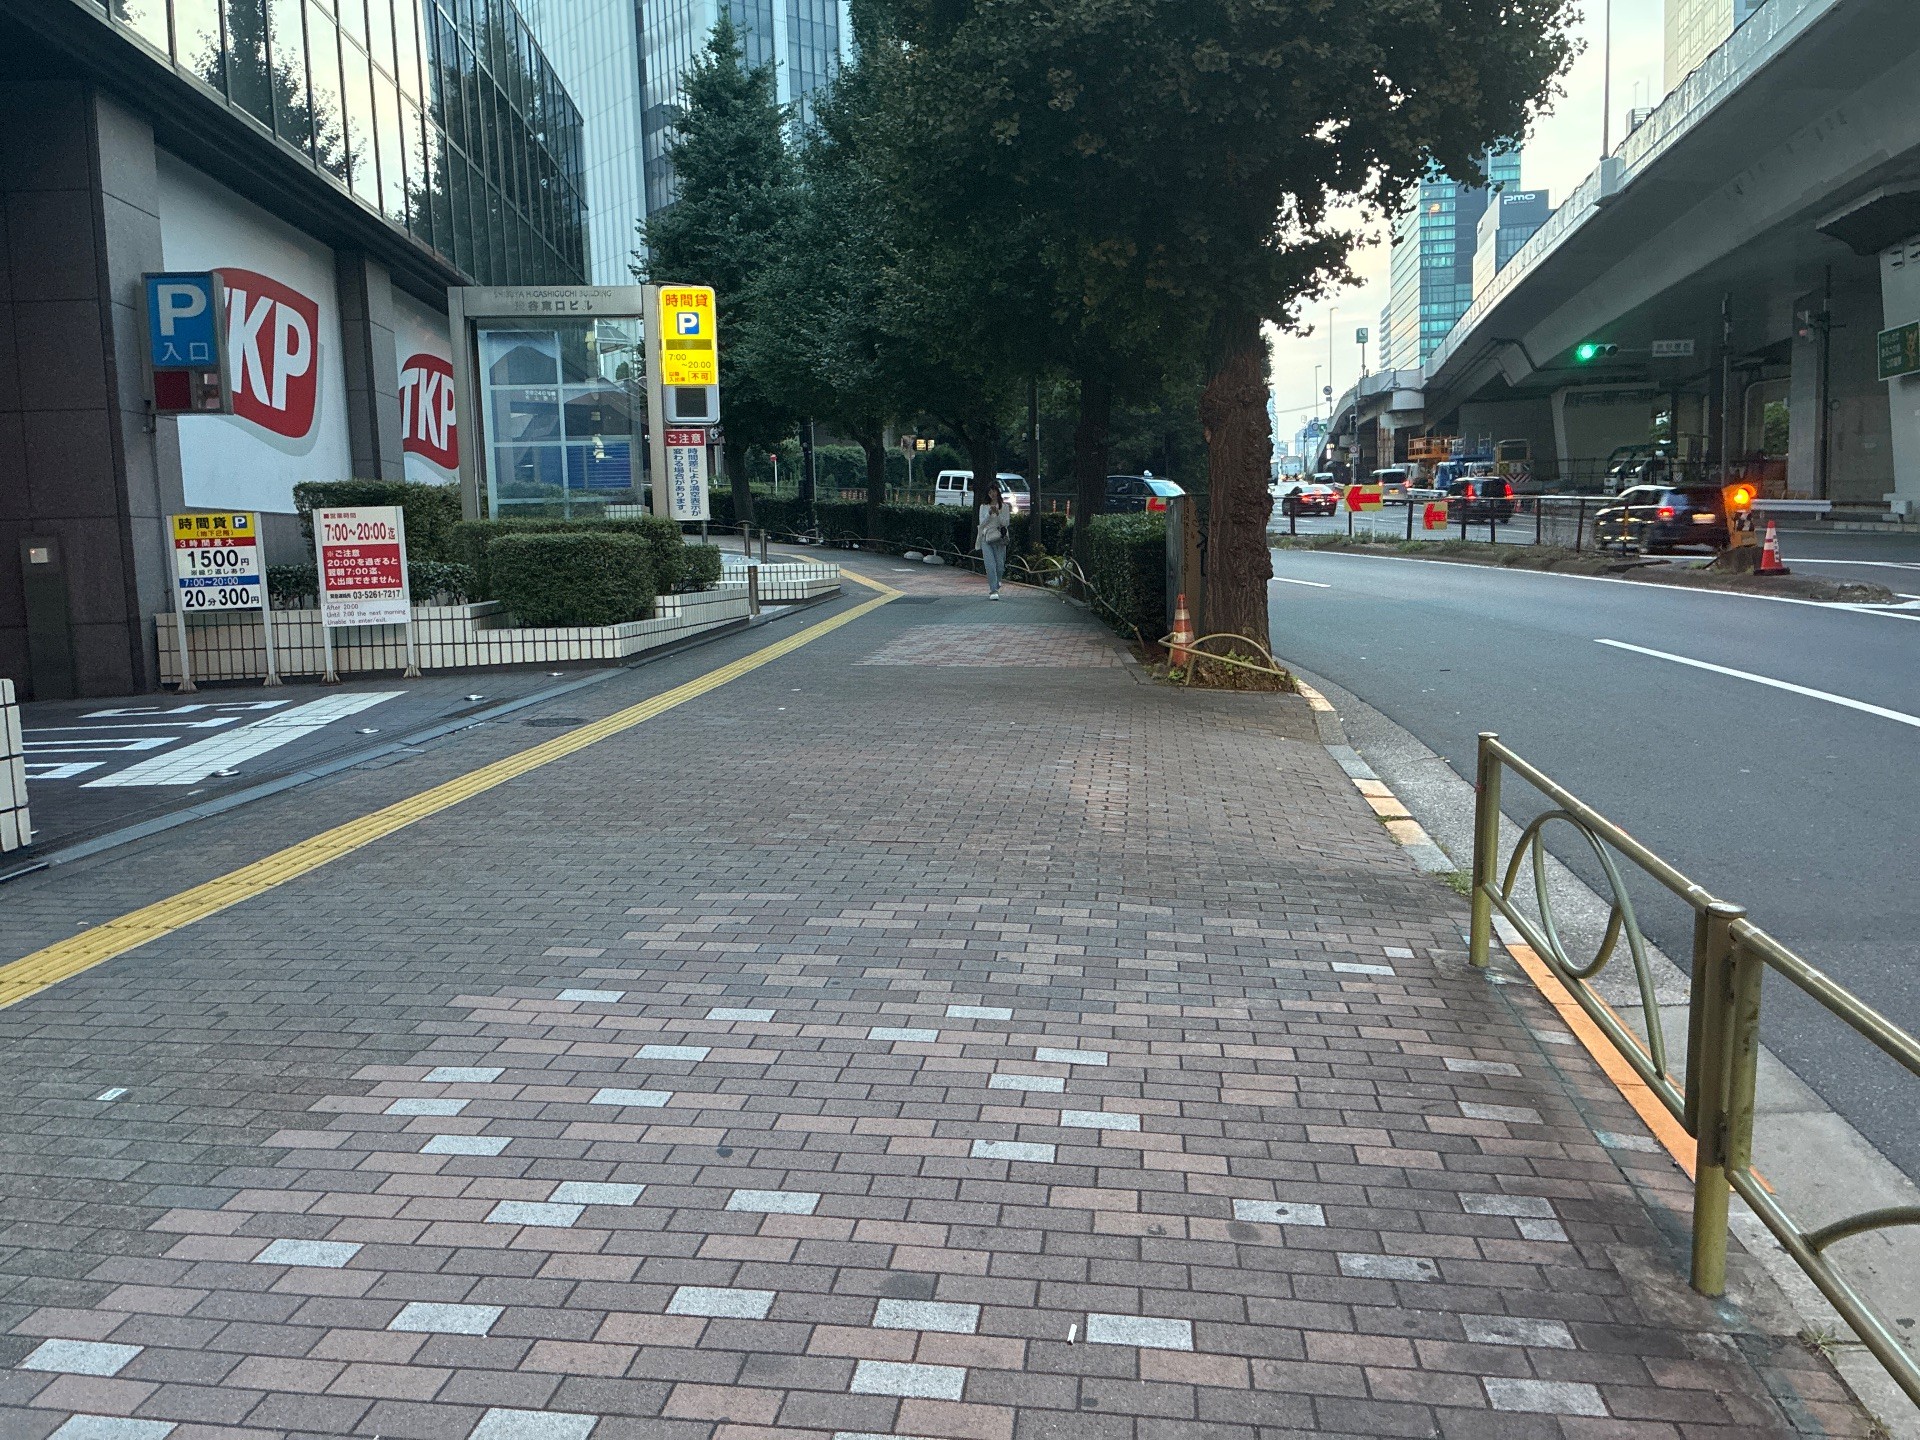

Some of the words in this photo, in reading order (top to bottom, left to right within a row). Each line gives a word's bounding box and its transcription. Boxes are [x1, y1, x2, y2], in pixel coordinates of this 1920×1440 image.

[526, 290, 578, 299] HGASHIGUCHI
[665, 293, 708, 308] 時間貸
[157, 283, 206, 336] P
[678, 313, 697, 334] P
[161, 342, 209, 361] 入口
[224, 286, 311, 412] KP
[668, 353, 687, 361] 7:00
[690, 372, 709, 381] 不可
[667, 433, 702, 444] ご注意
[673, 447, 687, 514] 変わる場合があります。
[179, 517, 227, 529] 時間貸
[234, 517, 246, 528] P
[180, 539, 235, 548] 3時間最大
[327, 549, 360, 558] ※ご注意
[187, 549, 250, 569] 1500円
[327, 557, 398, 567] 20:00を過ぎると
[328, 576, 400, 586] 入出庫できません。
[352, 589, 401, 600] 03-5261-7217
[326, 603, 340, 611] After
[384, 608, 406, 616] morning
[327, 618, 347, 626] Unable
